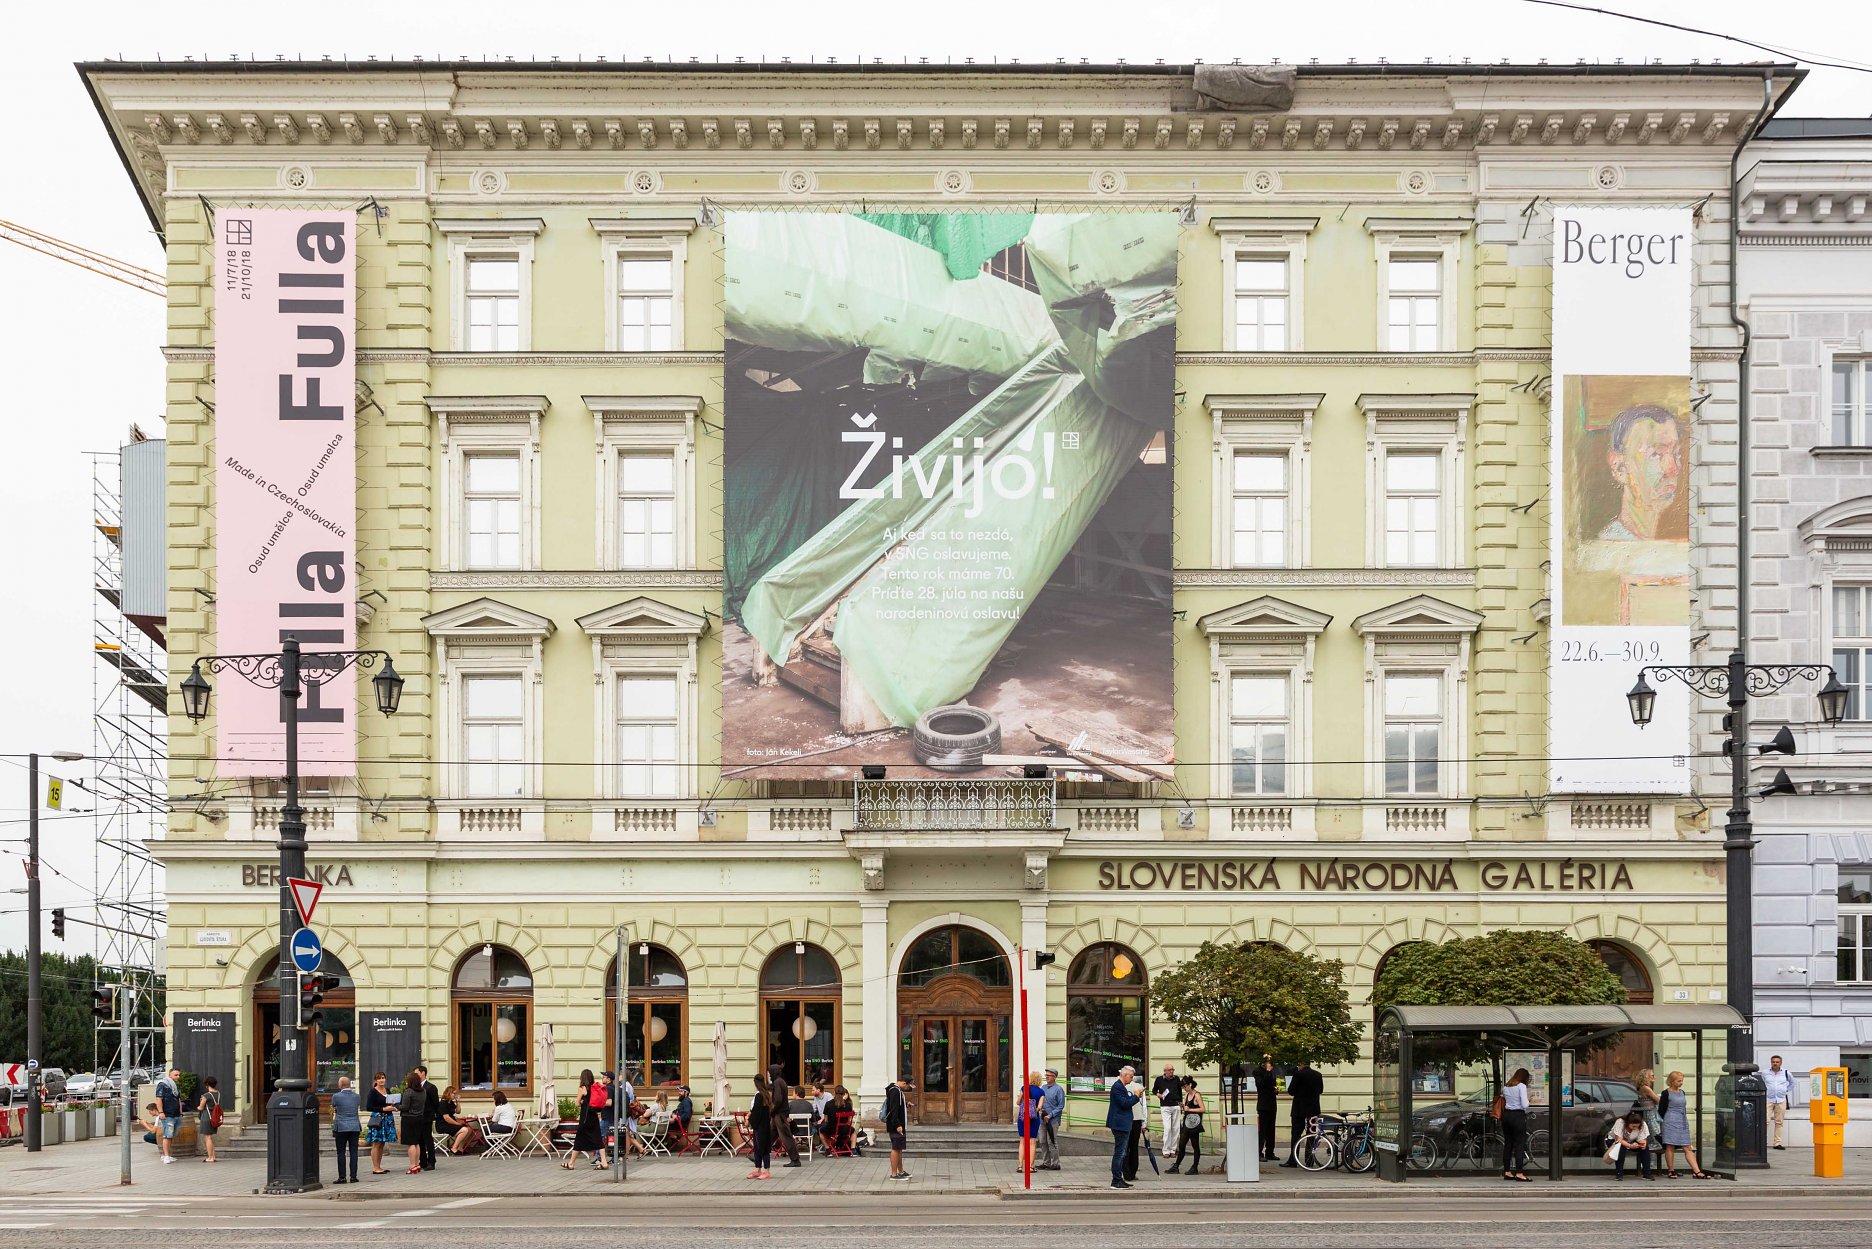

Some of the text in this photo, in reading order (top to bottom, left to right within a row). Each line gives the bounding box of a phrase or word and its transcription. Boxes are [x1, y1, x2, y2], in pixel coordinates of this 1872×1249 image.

[1561, 219, 1684, 279] Berger
[227, 250, 239, 291] 11/7/18
[241, 250, 253, 300] 21/10/18
[278, 221, 346, 421] Fulla
[298, 433, 343, 496] Osud umelca
[839, 412, 1055, 519] Živijó!
[224, 456, 346, 539] Made in Czechoslovakia
[248, 510, 294, 574] Osud umělce
[882, 527, 897, 543] Aj
[931, 530, 946, 541] sa
[950, 529, 964, 541] to
[968, 528, 1013, 542] nezdá,
[884, 546, 1012, 562] v SNG oslavujeme.
[881, 566, 1015, 580] Tento rok máme 70.
[918, 586, 938, 600] 28.
[942, 586, 966, 603] júla
[971, 589, 988, 600] na
[992, 587, 1024, 600] našu
[876, 606, 1020, 620] narodeninovú oslavu!
[746, 747, 764, 756] foto:
[766, 747, 779, 756] Ján
[51, 787, 60, 801] 15
[242, 864, 354, 887] BERNKA
[1098, 857, 1634, 891] SLOVENSKÁ NÁRODNÁ GALÉRIA
[187, 1018, 221, 1027] Berlinka
[373, 1017, 407, 1026] Berlinka
